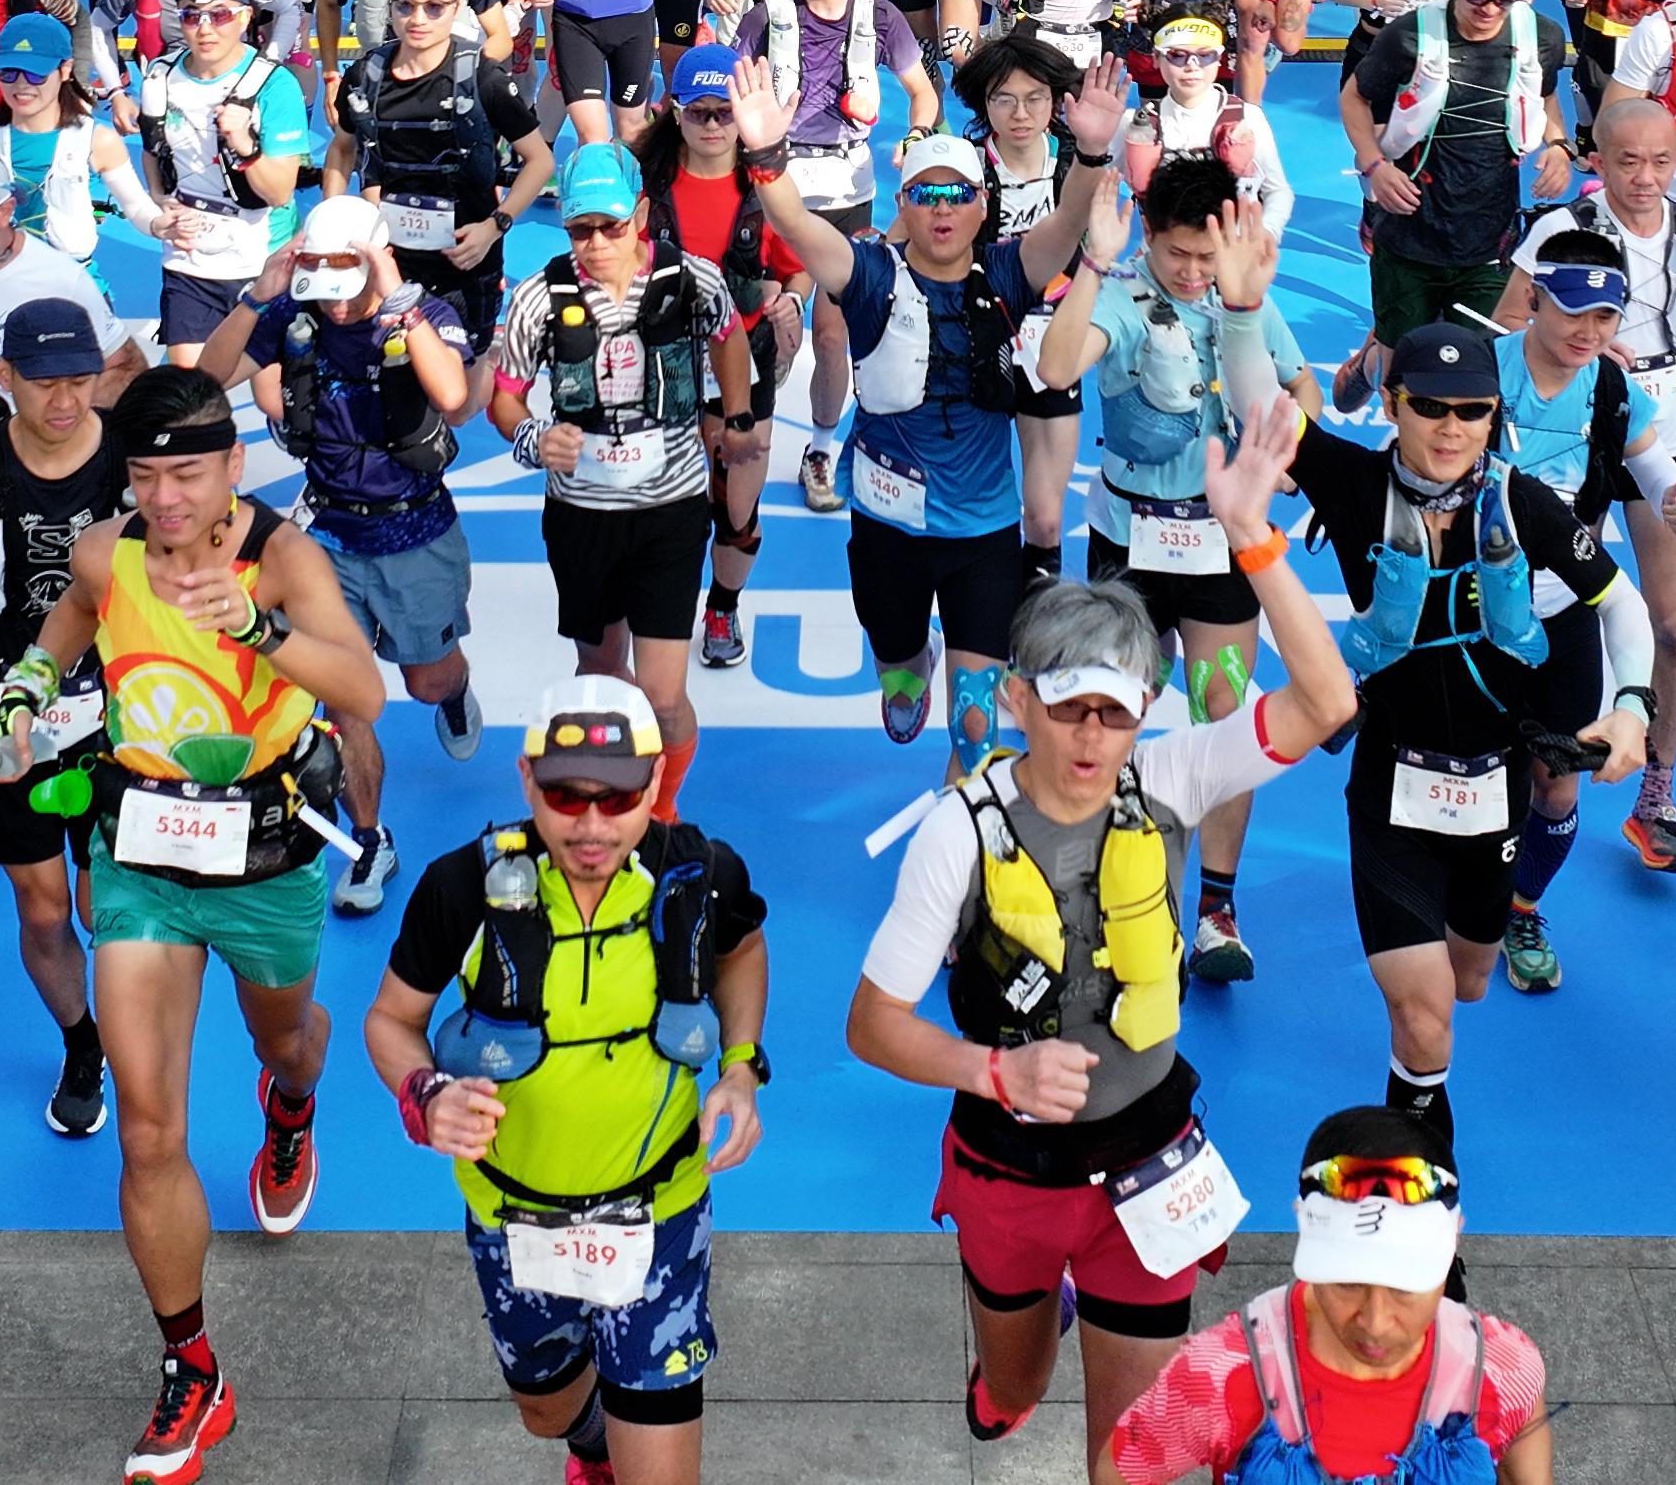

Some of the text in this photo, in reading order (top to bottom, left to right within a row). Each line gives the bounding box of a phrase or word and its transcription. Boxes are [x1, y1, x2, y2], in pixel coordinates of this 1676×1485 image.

[399, 217, 431, 231] 5121
[595, 446, 642, 464] 5423
[1158, 532, 1202, 548] 5335
[1428, 784, 1480, 805] 5181
[171, 804, 202, 816] MXM
[154, 816, 218, 839] 5344
[1165, 1177, 1217, 1223] 5280
[553, 1240, 617, 1266] 5189
